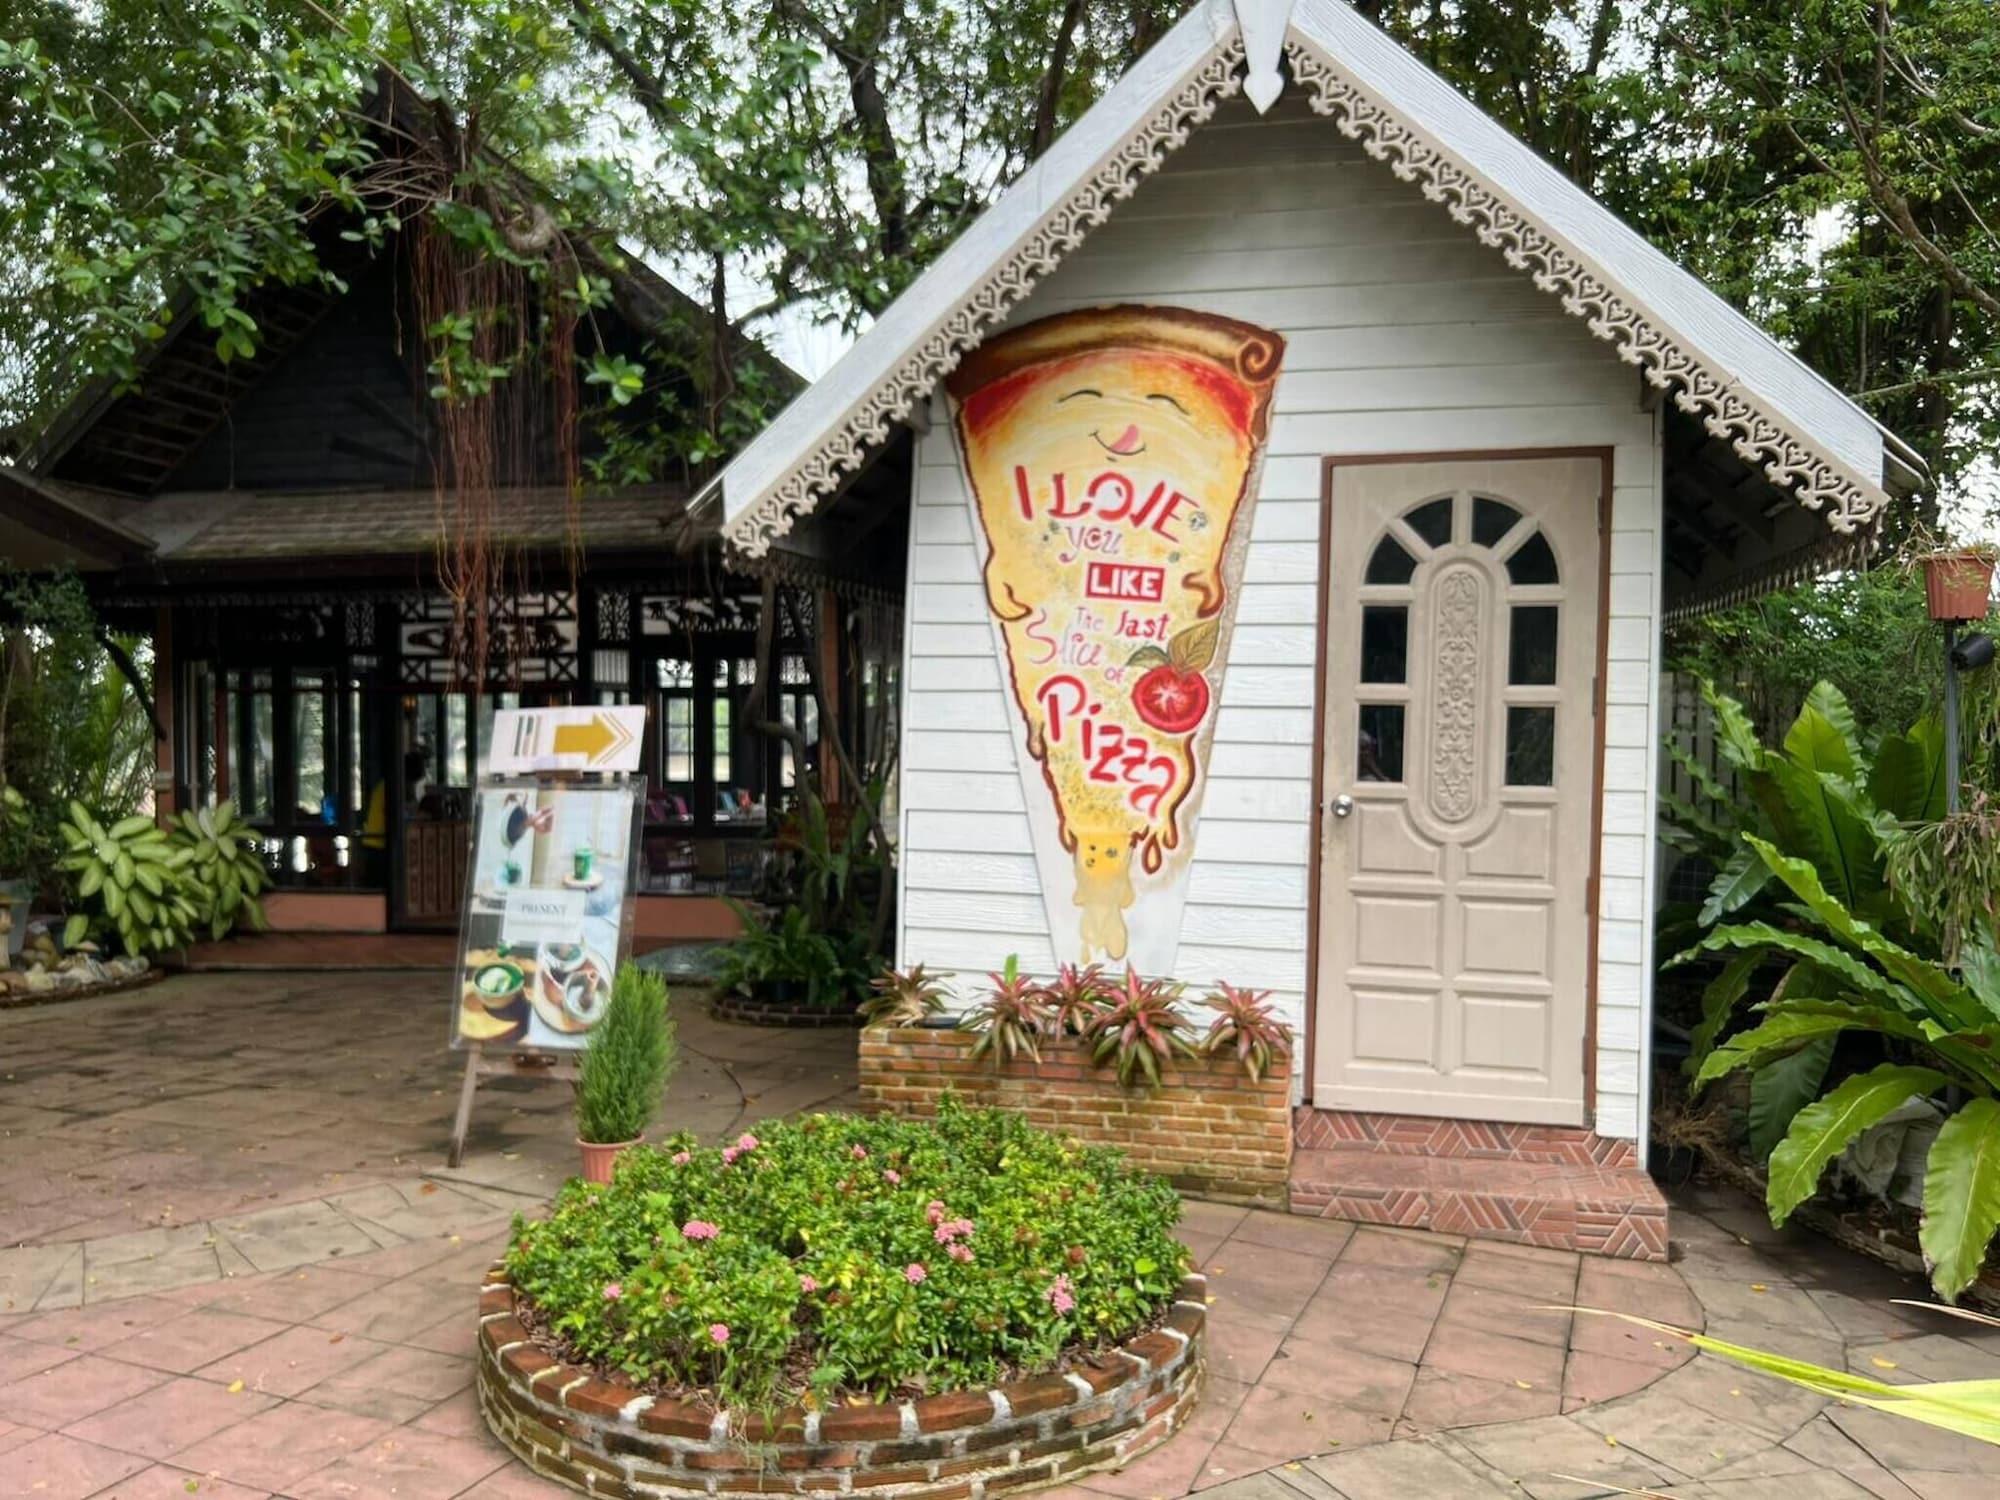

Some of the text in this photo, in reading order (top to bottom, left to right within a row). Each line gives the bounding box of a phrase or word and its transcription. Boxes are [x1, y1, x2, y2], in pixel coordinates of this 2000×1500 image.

[1014, 464, 1201, 543] I LOVE
[1058, 525, 1123, 563] you
[1090, 566, 1161, 598] LIKE
[1113, 609, 1171, 641] last
[1036, 674, 1177, 818] Pizza
